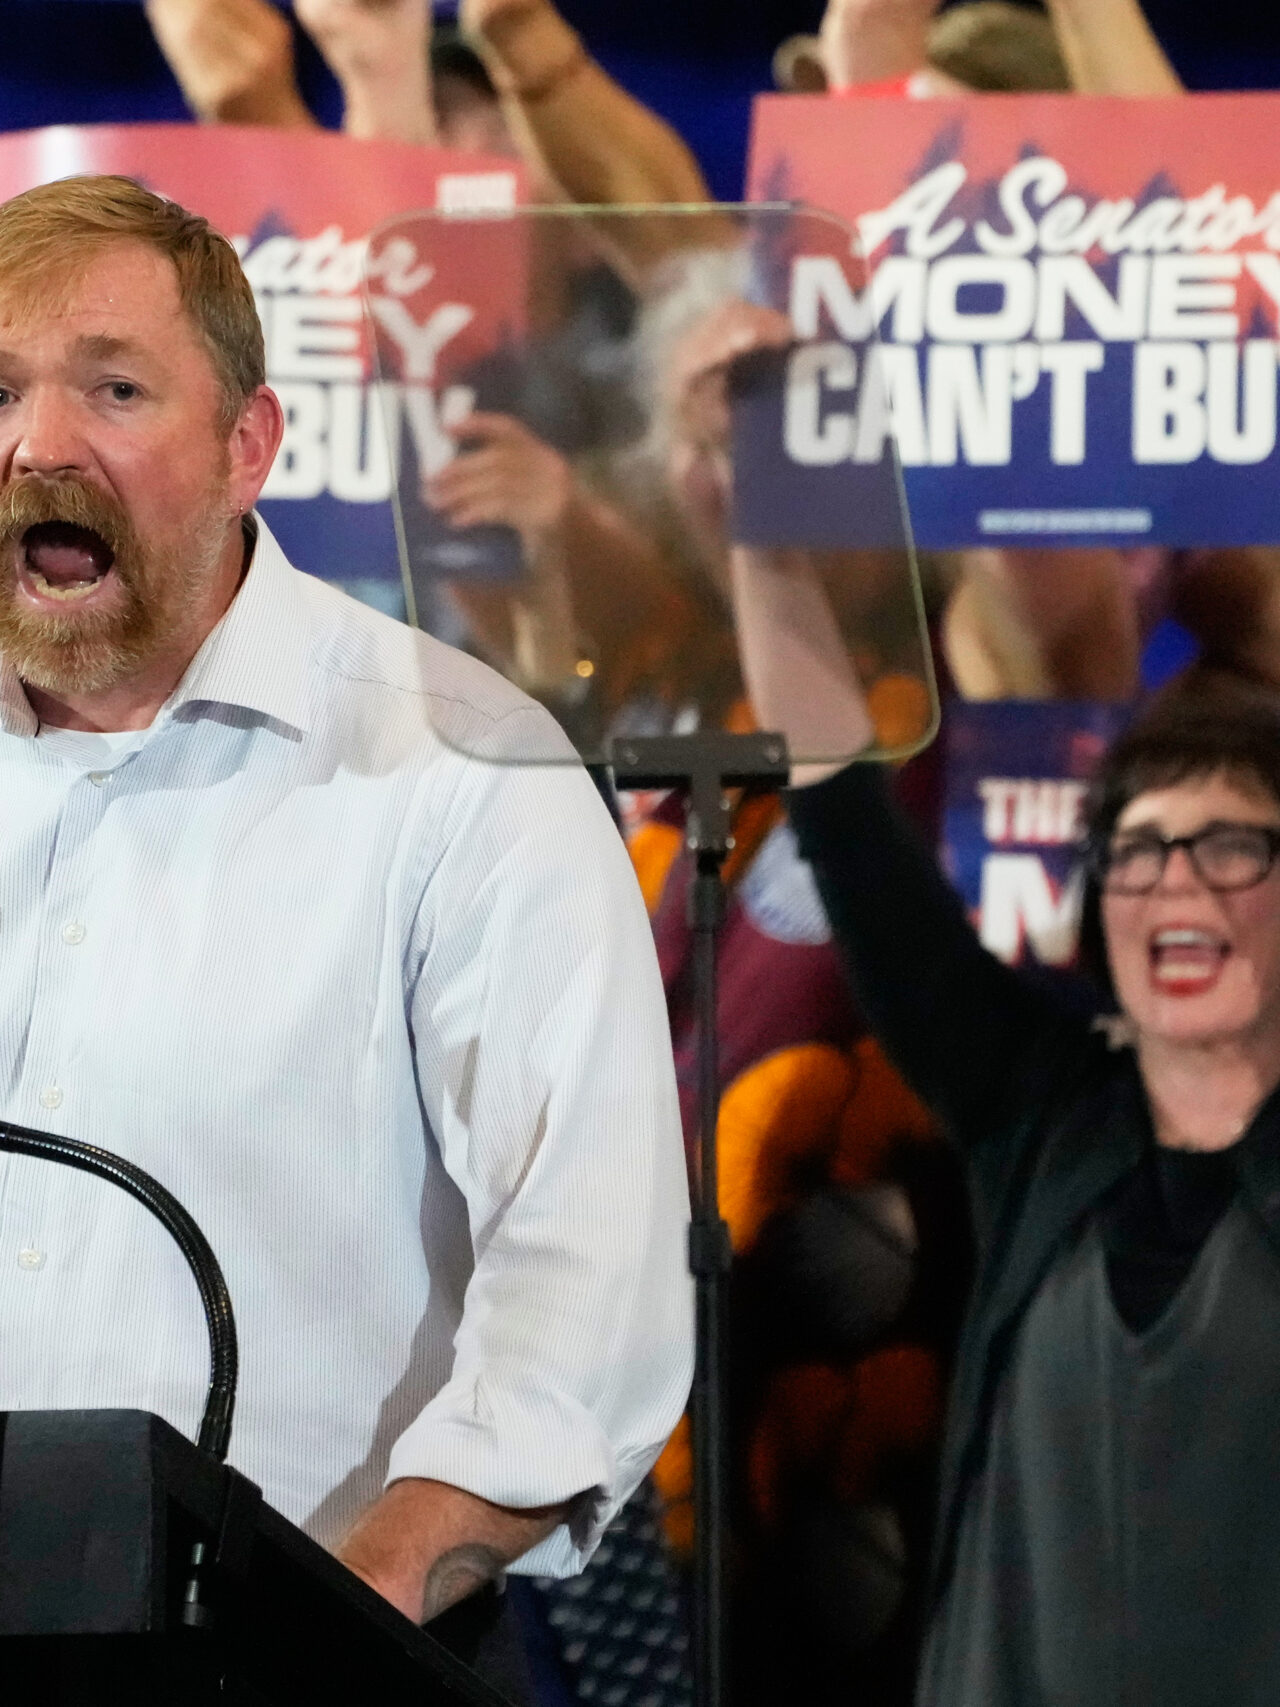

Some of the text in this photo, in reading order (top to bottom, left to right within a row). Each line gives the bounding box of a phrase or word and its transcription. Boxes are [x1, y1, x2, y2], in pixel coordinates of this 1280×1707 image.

[858, 162, 967, 257] A
[783, 338, 1280, 467] CAN'T BU
